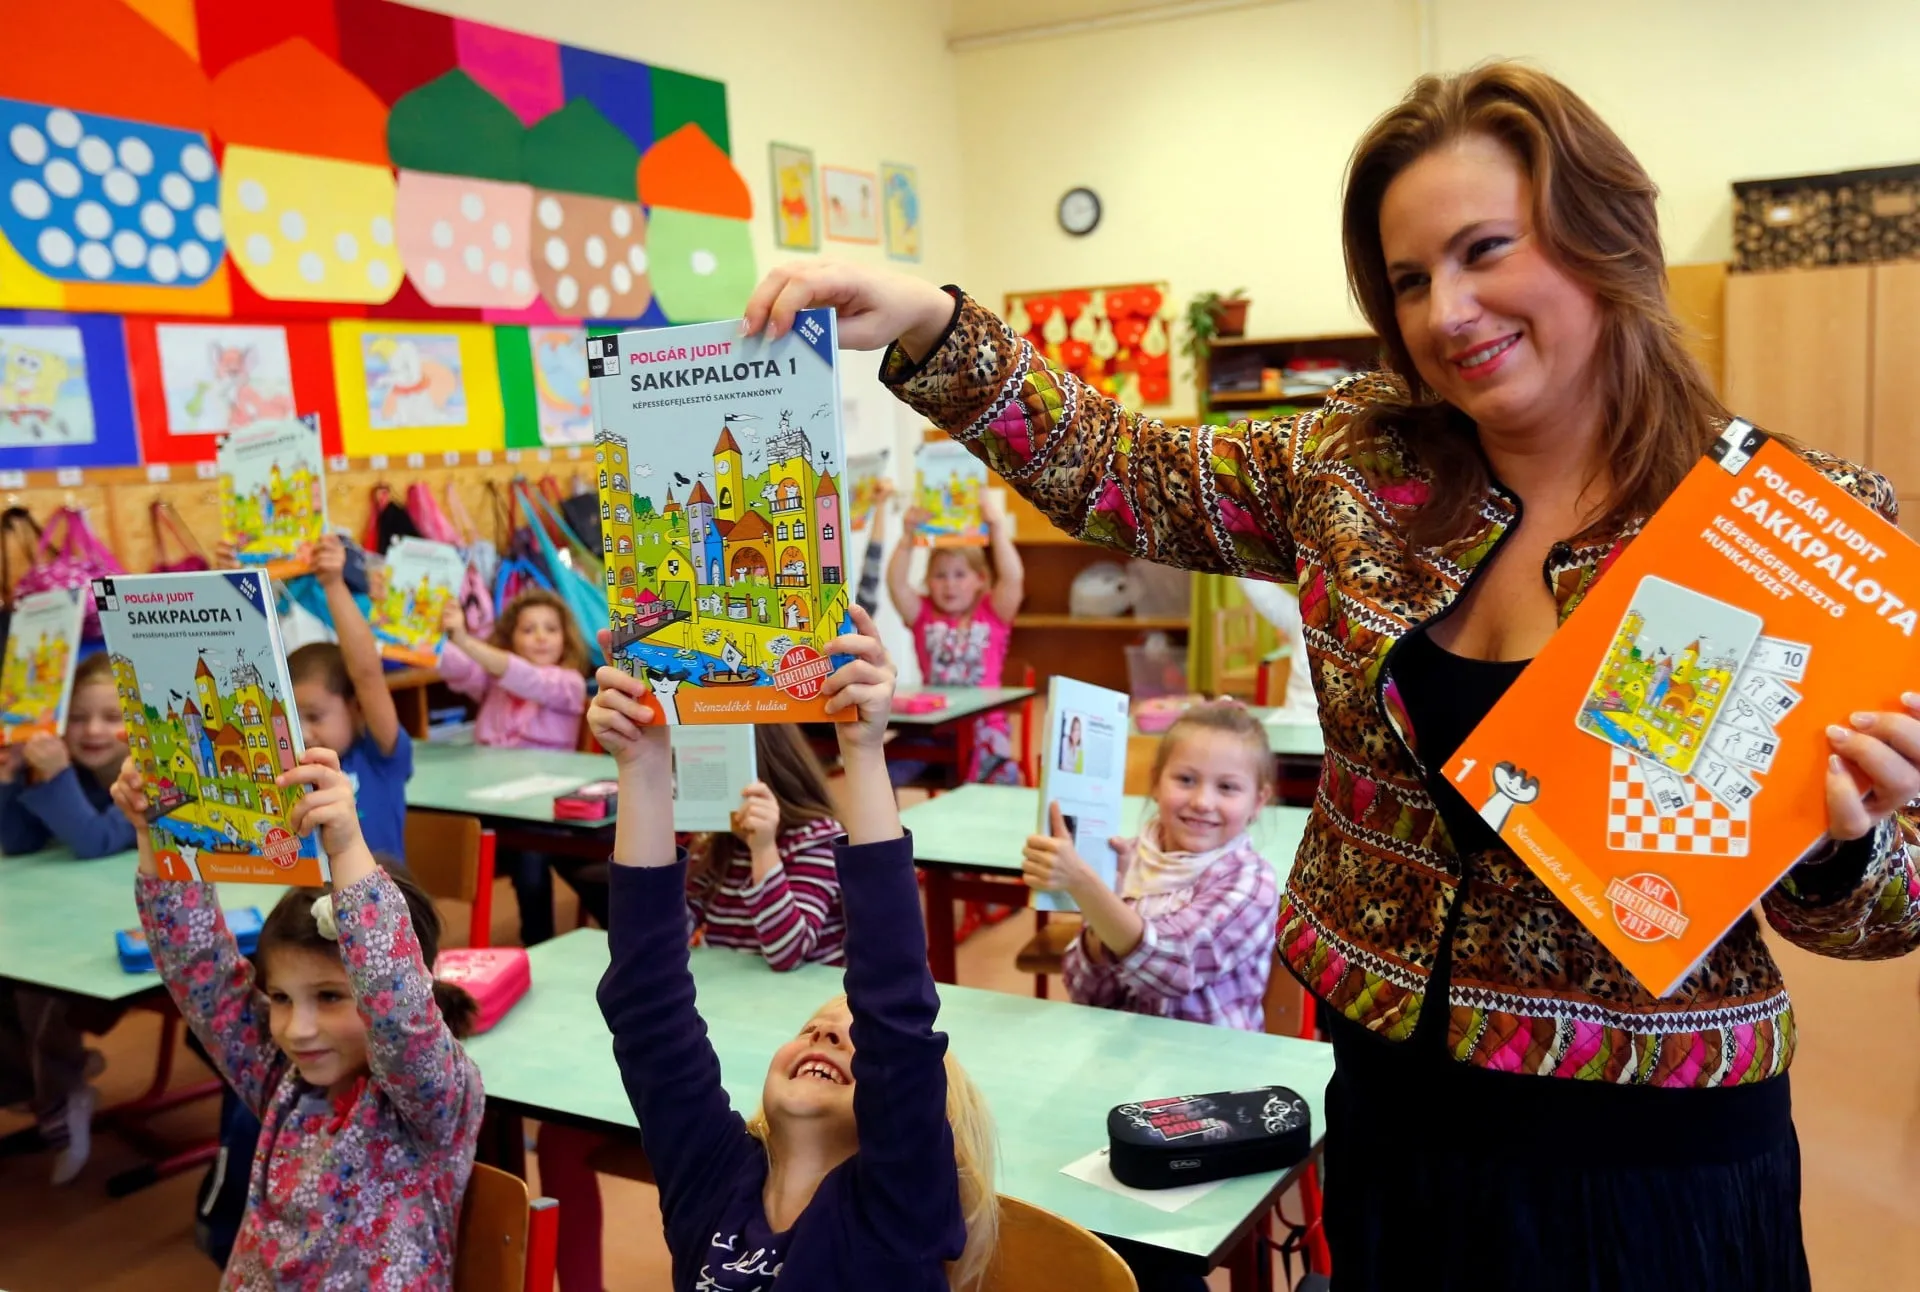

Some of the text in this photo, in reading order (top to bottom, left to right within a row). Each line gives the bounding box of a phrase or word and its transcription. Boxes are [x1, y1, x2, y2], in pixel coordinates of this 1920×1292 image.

[799, 327, 818, 346] 2012
[804, 316, 825, 337] NAT
[630, 342, 732, 365] POLGÁR JUDIT
[630, 357, 797, 392] SAKKPALOTA 1
[713, 387, 783, 401] SAKKTANKÖNYV
[1754, 465, 1888, 564] POLGÁR JUDIT
[1700, 528, 1794, 601] MUNKAFÜZET
[1730, 486, 1918, 637] SAKKPALOTA
[124, 592, 194, 605] POLGÁR JUDIT
[128, 608, 243, 625] SAKKPALOTA 1
[787, 650, 808, 667] NAT
[1784, 651, 1803, 667] 10
[776, 658, 831, 689] KERETTANTERV
[797, 685, 818, 697] 2012
[694, 701, 752, 713] Nemzedékek
[1455, 758, 1477, 783] 1
[163, 856, 174, 876] 1
[1640, 877, 1670, 902] NAT
[1621, 911, 1651, 938] 2012
